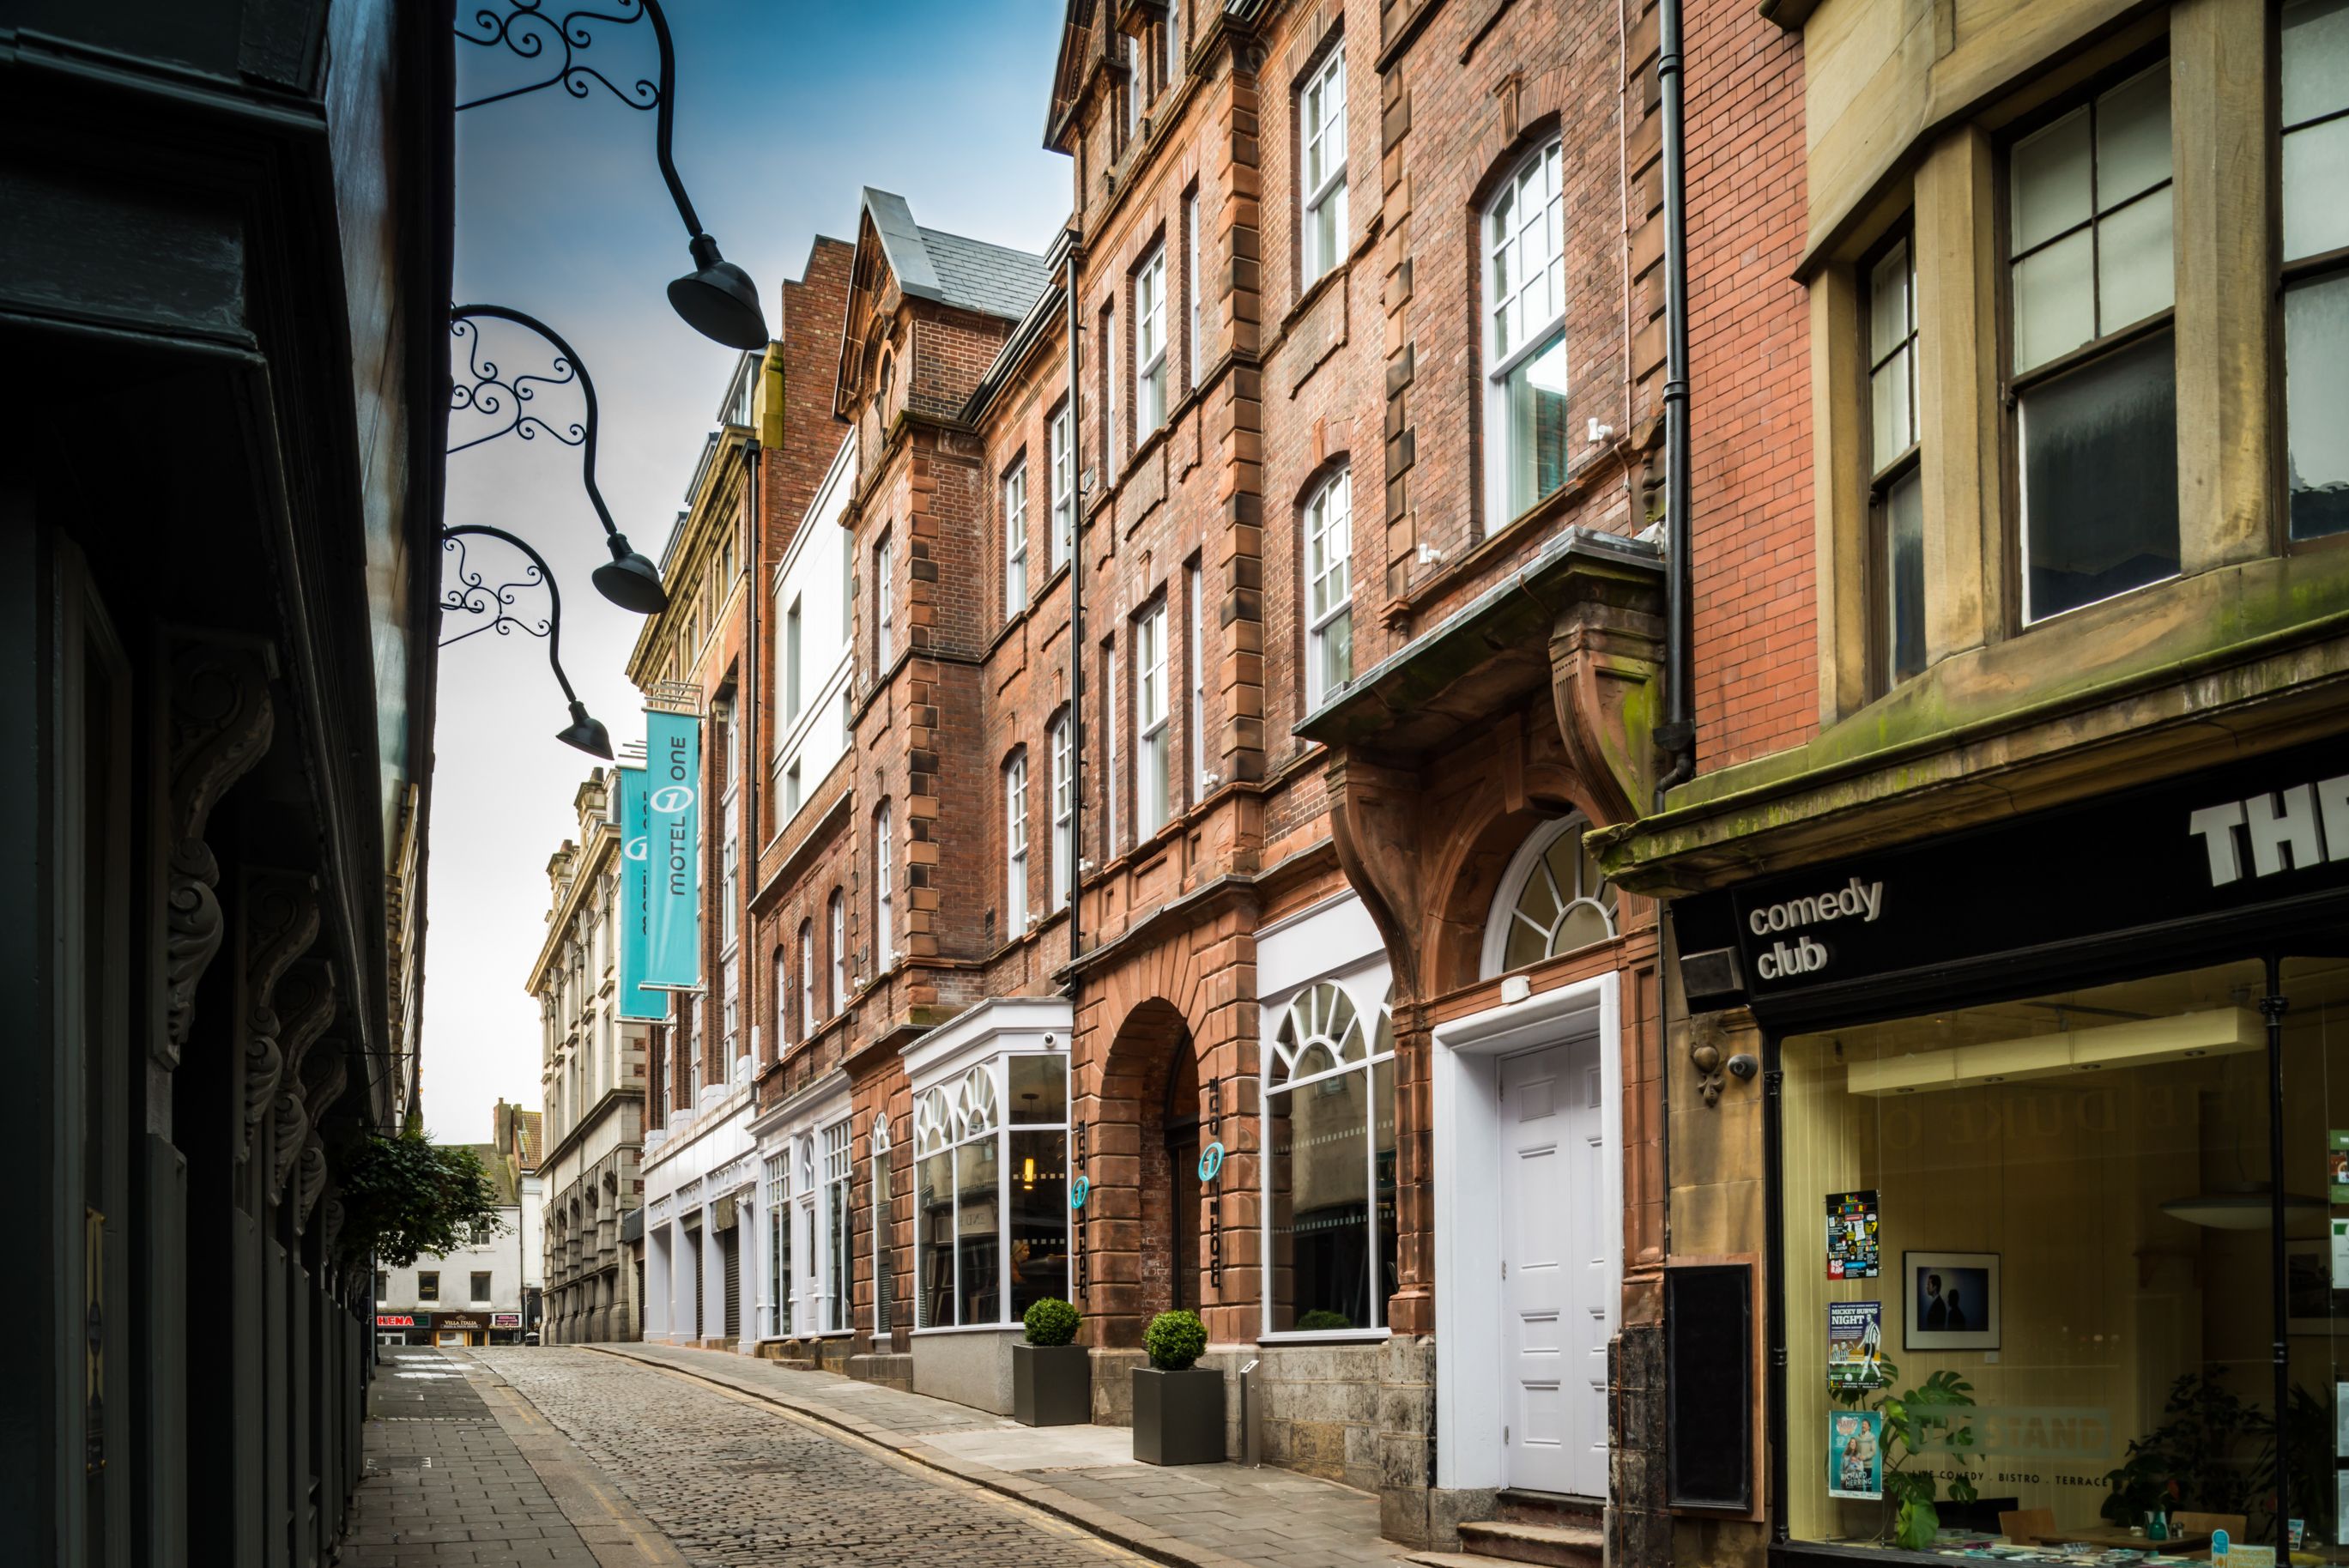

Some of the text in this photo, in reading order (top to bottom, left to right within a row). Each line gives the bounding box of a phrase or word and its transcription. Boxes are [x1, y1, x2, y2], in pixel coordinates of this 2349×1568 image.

[670, 736, 687, 782] ONE
[669, 816, 686, 896] MOTEL
[1749, 876, 1883, 935] comedy
[1758, 935, 1828, 980] club
[1831, 1315, 1865, 1325] NIGHT
[1984, 1415, 2107, 1450] STAND
[1845, 1477, 1872, 1486] HERRING
[1911, 1469, 2108, 1487] LIVE COMEDY BISTRO TERRACE
